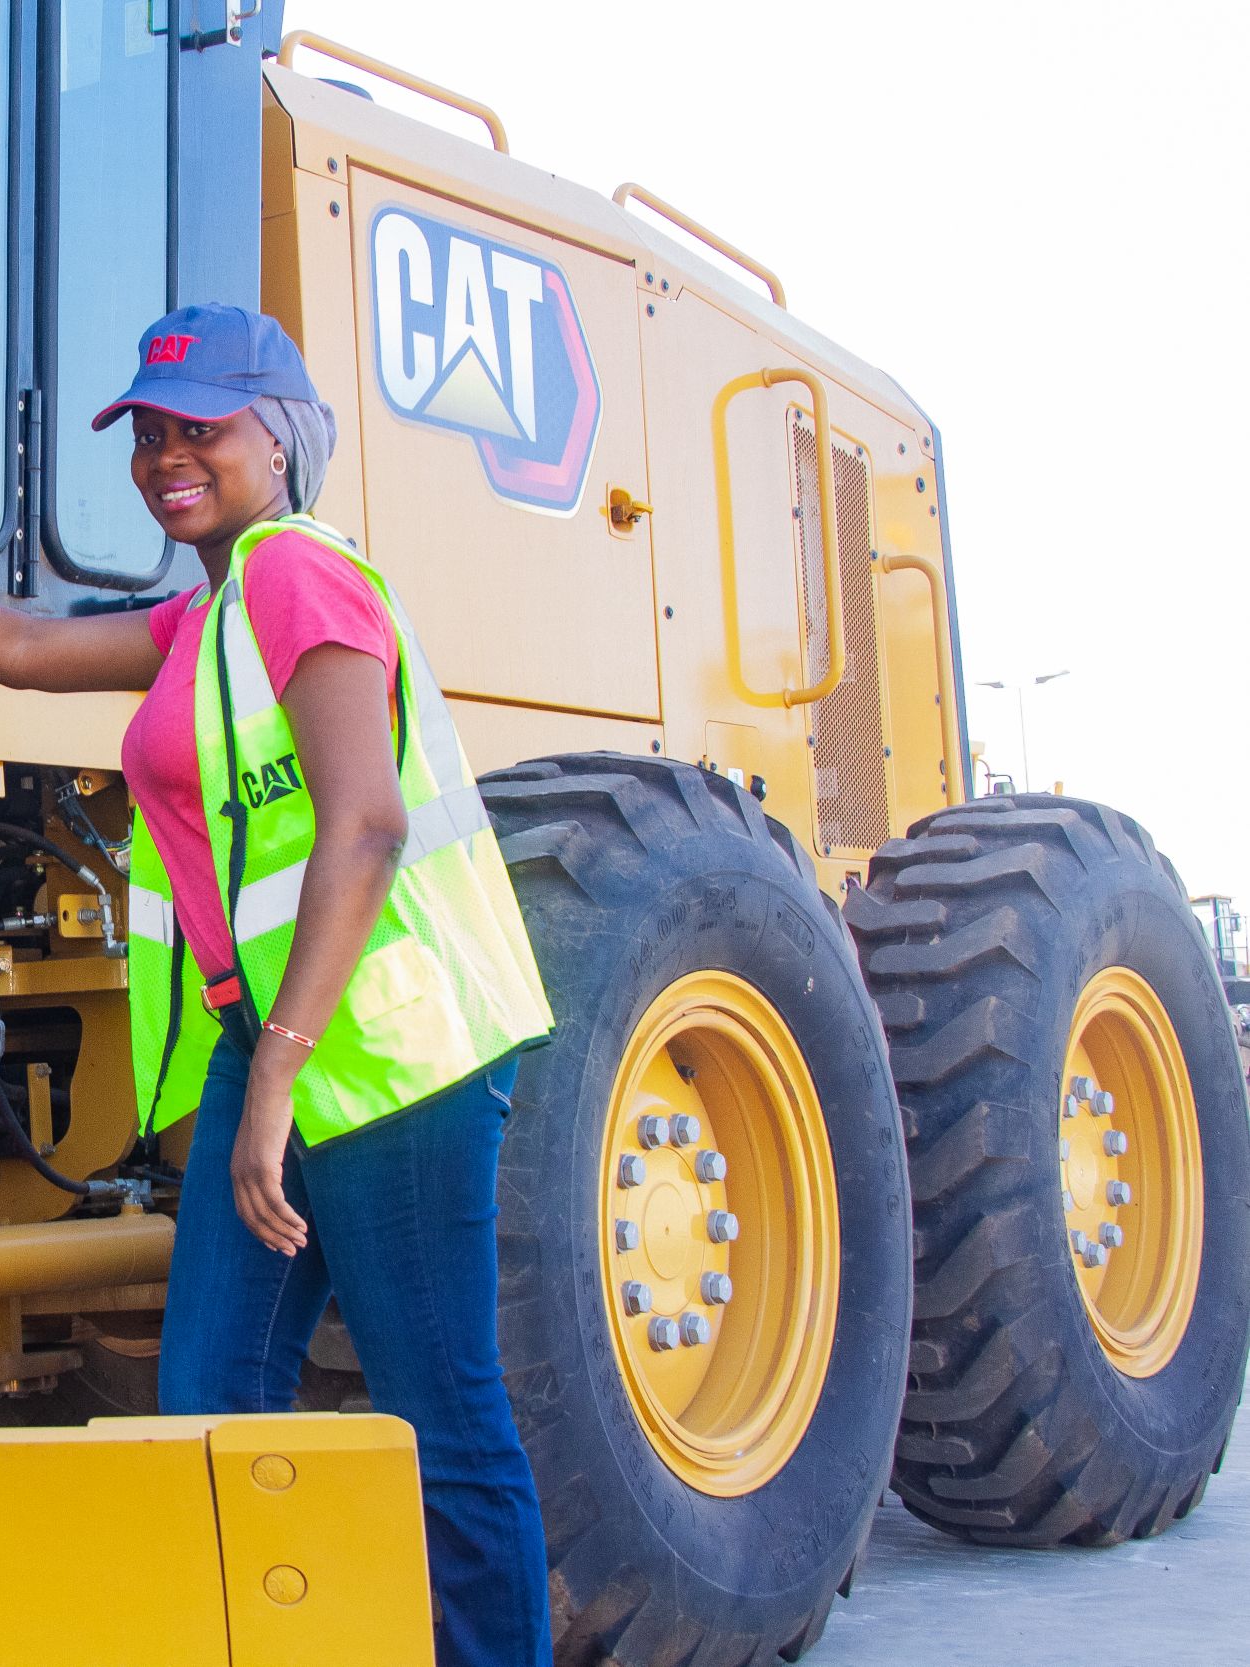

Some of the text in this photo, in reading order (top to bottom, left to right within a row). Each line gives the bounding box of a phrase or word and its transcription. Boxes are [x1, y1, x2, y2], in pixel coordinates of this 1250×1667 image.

[146, 334, 194, 366] CAT
[374, 213, 543, 443] CAT
[242, 752, 303, 808] CAT
